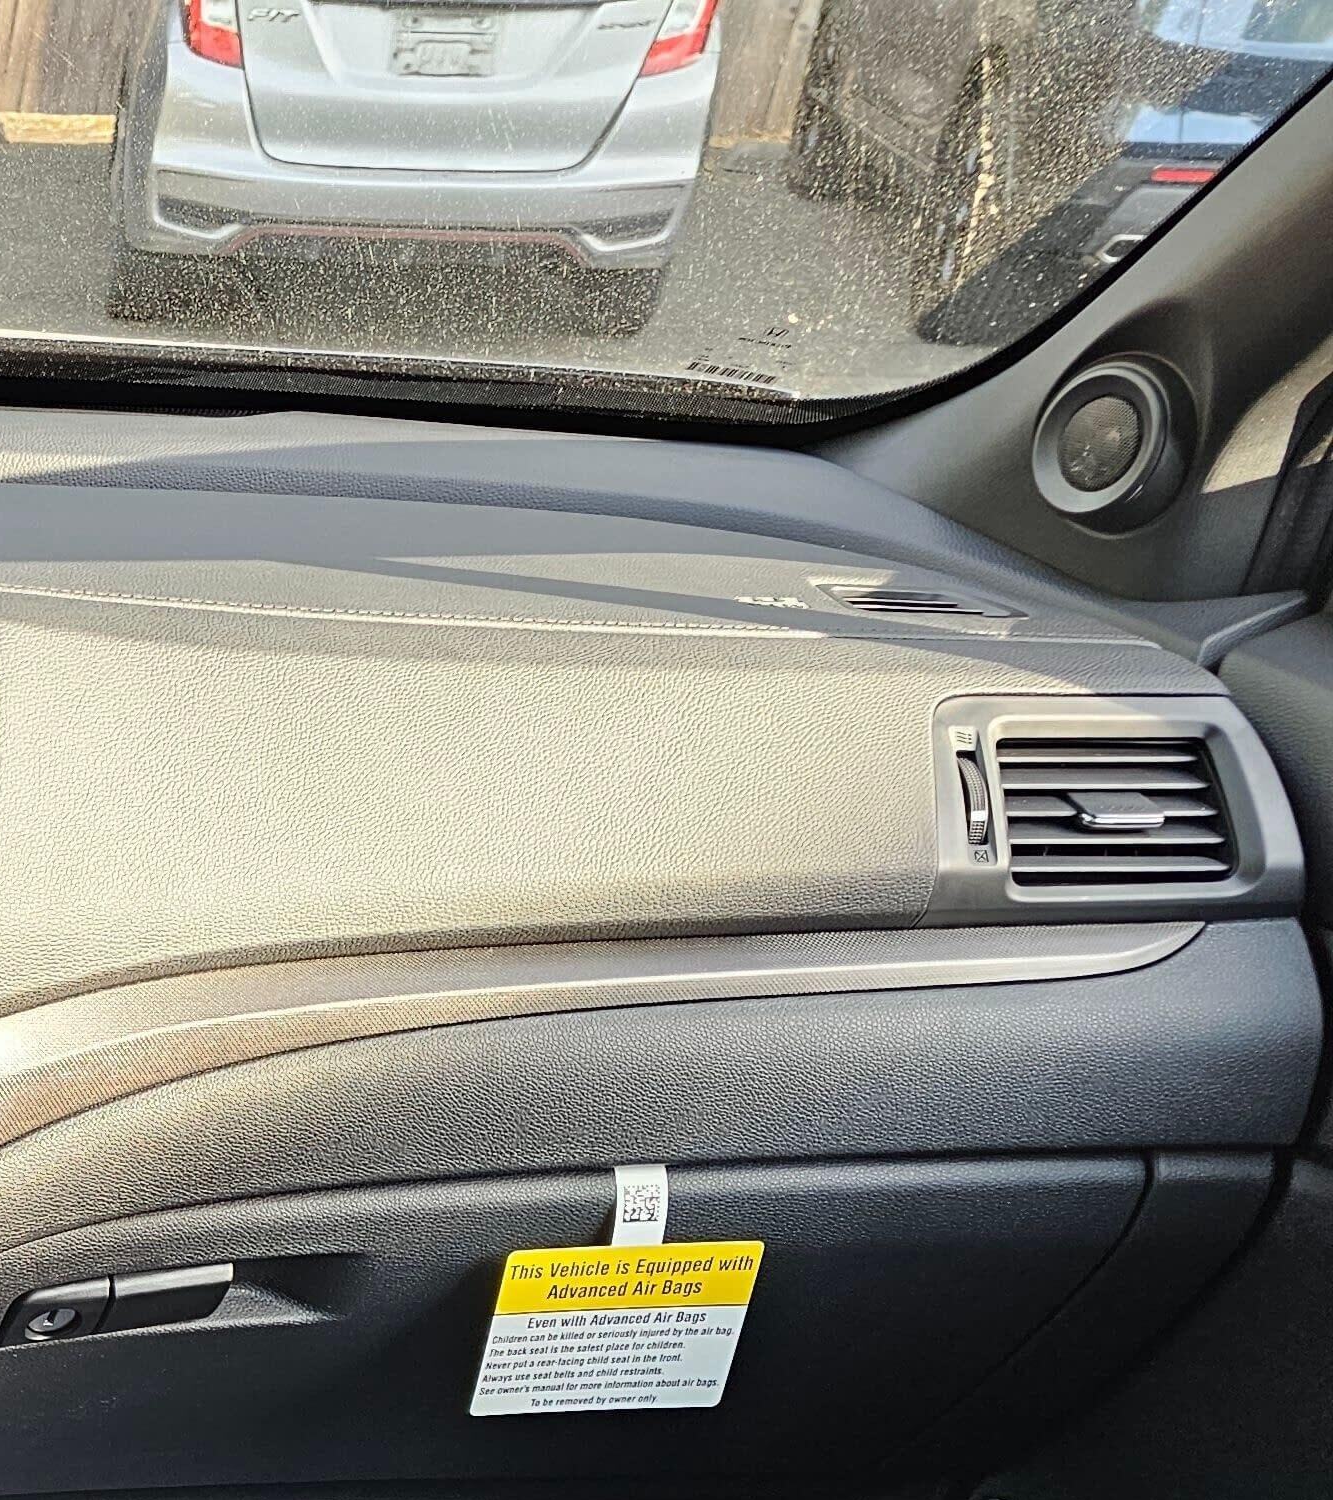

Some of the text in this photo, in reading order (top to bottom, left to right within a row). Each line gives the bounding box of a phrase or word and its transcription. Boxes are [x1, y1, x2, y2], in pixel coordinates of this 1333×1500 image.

[511, 1256, 754, 1280] This Vehicle is Equipped with
[546, 1280, 703, 1300] Advanced Air Bags
[527, 1311, 707, 1329] Even with Advanced Air Bags
[492, 1335, 528, 1344] Children
[529, 1334, 545, 1342] can
[547, 1333, 558, 1341] be
[560, 1331, 584, 1340] killed
[598, 1330, 636, 1340] seriously
[639, 1328, 669, 1339] injured
[672, 1327, 683, 1337] by
[685, 1327, 699, 1335] the
[701, 1328, 714, 1336] air
[489, 1341, 685, 1357] The back seat is the safest place for children.
[485, 1361, 511, 1370] Never
[513, 1360, 528, 1370] put
[537, 1357, 585, 1367] rear-facing
[587, 1356, 609, 1365] child
[611, 1354, 630, 1364] seat
[632, 1354, 641, 1363] in
[643, 1353, 657, 1362] the
[482, 1374, 512, 1383] Always
[533, 1371, 552, 1380] seat
[554, 1370, 575, 1379] belts
[577, 1369, 594, 1378] and
[596, 1367, 618, 1376] child
[479, 1387, 495, 1396] See
[497, 1385, 530, 1394] owner's
[532, 1383, 564, 1393] manual
[566, 1382, 578, 1391] for
[580, 1382, 603, 1390] more
[604, 1380, 654, 1389] information
[655, 1378, 680, 1387] about
[682, 1378, 694, 1387] air
[531, 1398, 541, 1407] To
[543, 1397, 554, 1406] be
[556, 1396, 594, 1406] removed
[596, 1396, 607, 1405] by
[609, 1396, 636, 1404] owner
